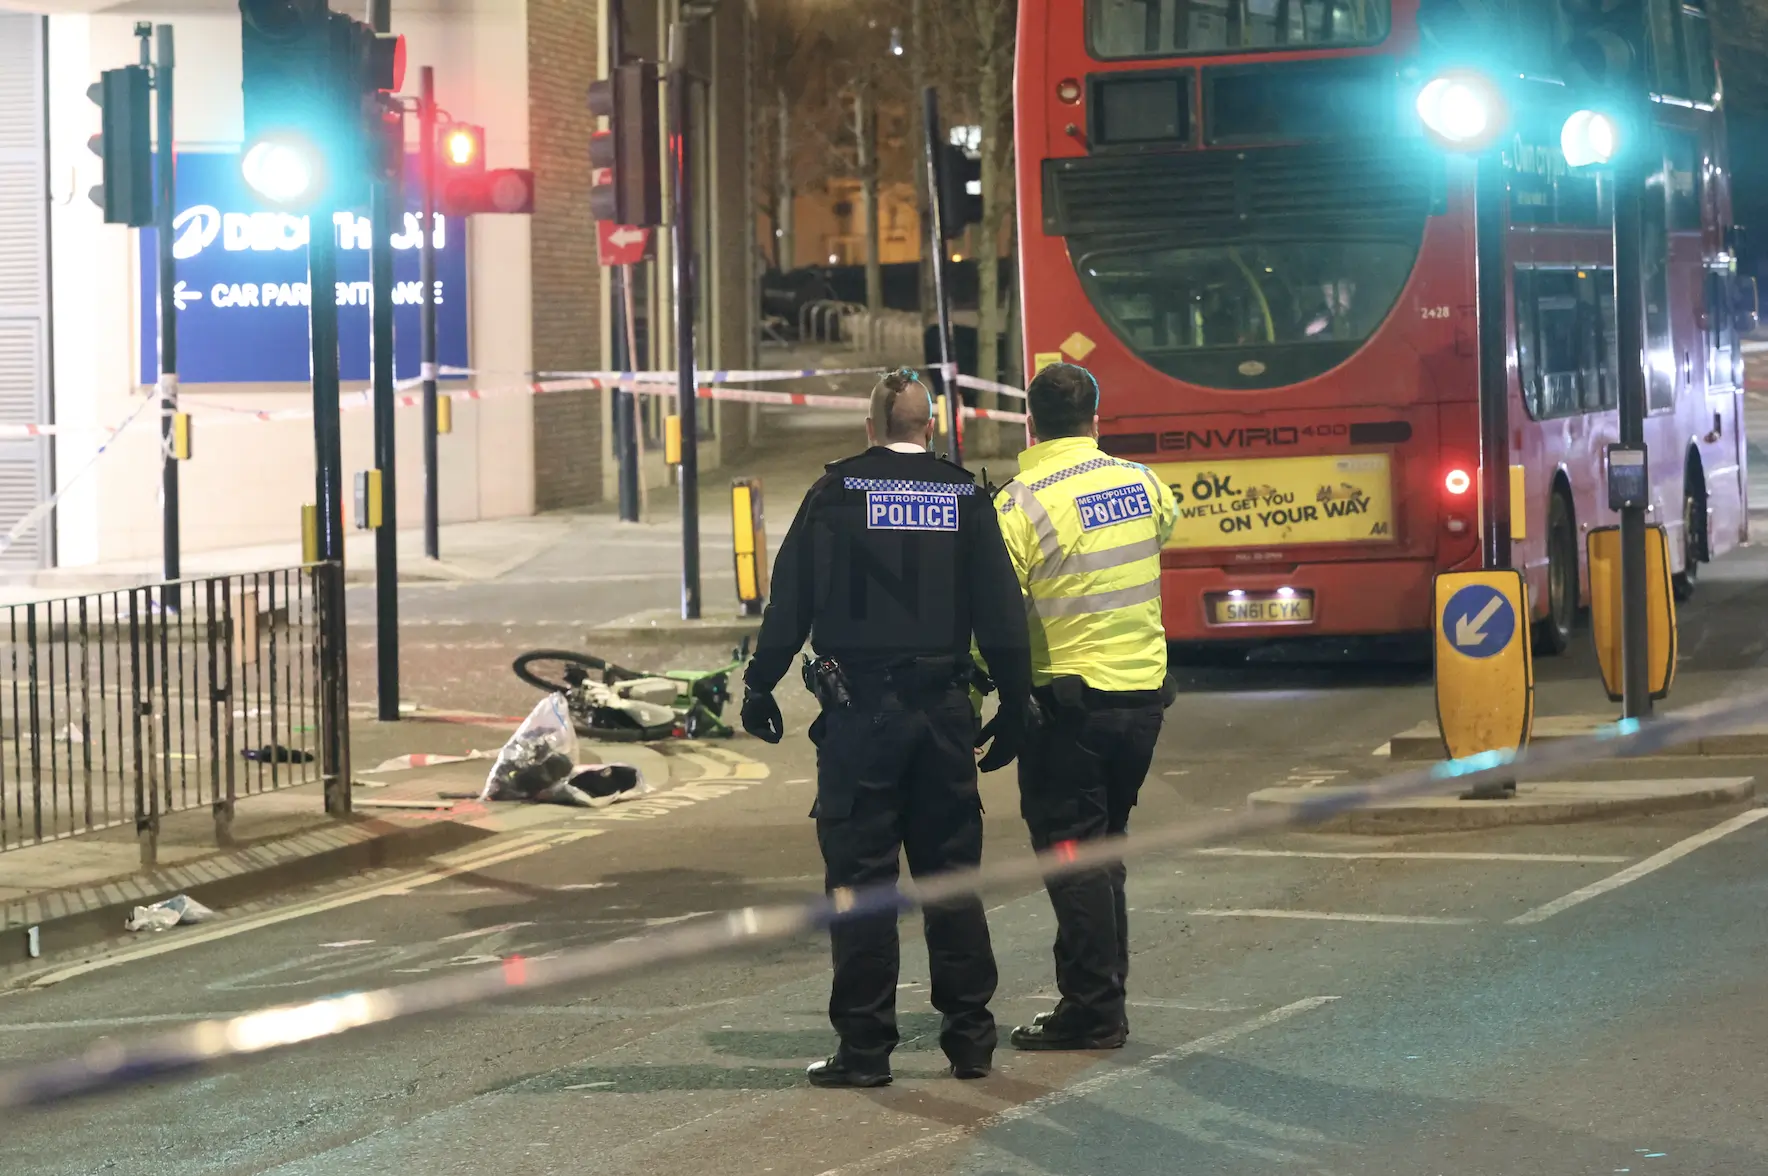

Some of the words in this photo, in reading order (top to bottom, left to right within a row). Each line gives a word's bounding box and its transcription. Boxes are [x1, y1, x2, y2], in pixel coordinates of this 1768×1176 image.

[223, 211, 445, 251] DECTHON
[211, 283, 259, 307] CAR
[262, 282, 310, 306] PAR
[1159, 427, 1298, 450] ENVIRO
[872, 495, 954, 504] METROPOLITAN
[1078, 485, 1144, 505] METROPOLITAN
[1192, 475, 1242, 500] OK.
[872, 504, 955, 526] POLICE
[1081, 493, 1151, 526] POLICE
[1181, 503, 1228, 518] WE'LL
[1231, 497, 1258, 511] GET
[1262, 492, 1294, 506] YOU
[1219, 514, 1252, 533] ON
[1257, 505, 1318, 528] YOUR
[1323, 496, 1371, 518] WAY
[1227, 604, 1264, 619] SN61
[1268, 603, 1302, 618] CYK
